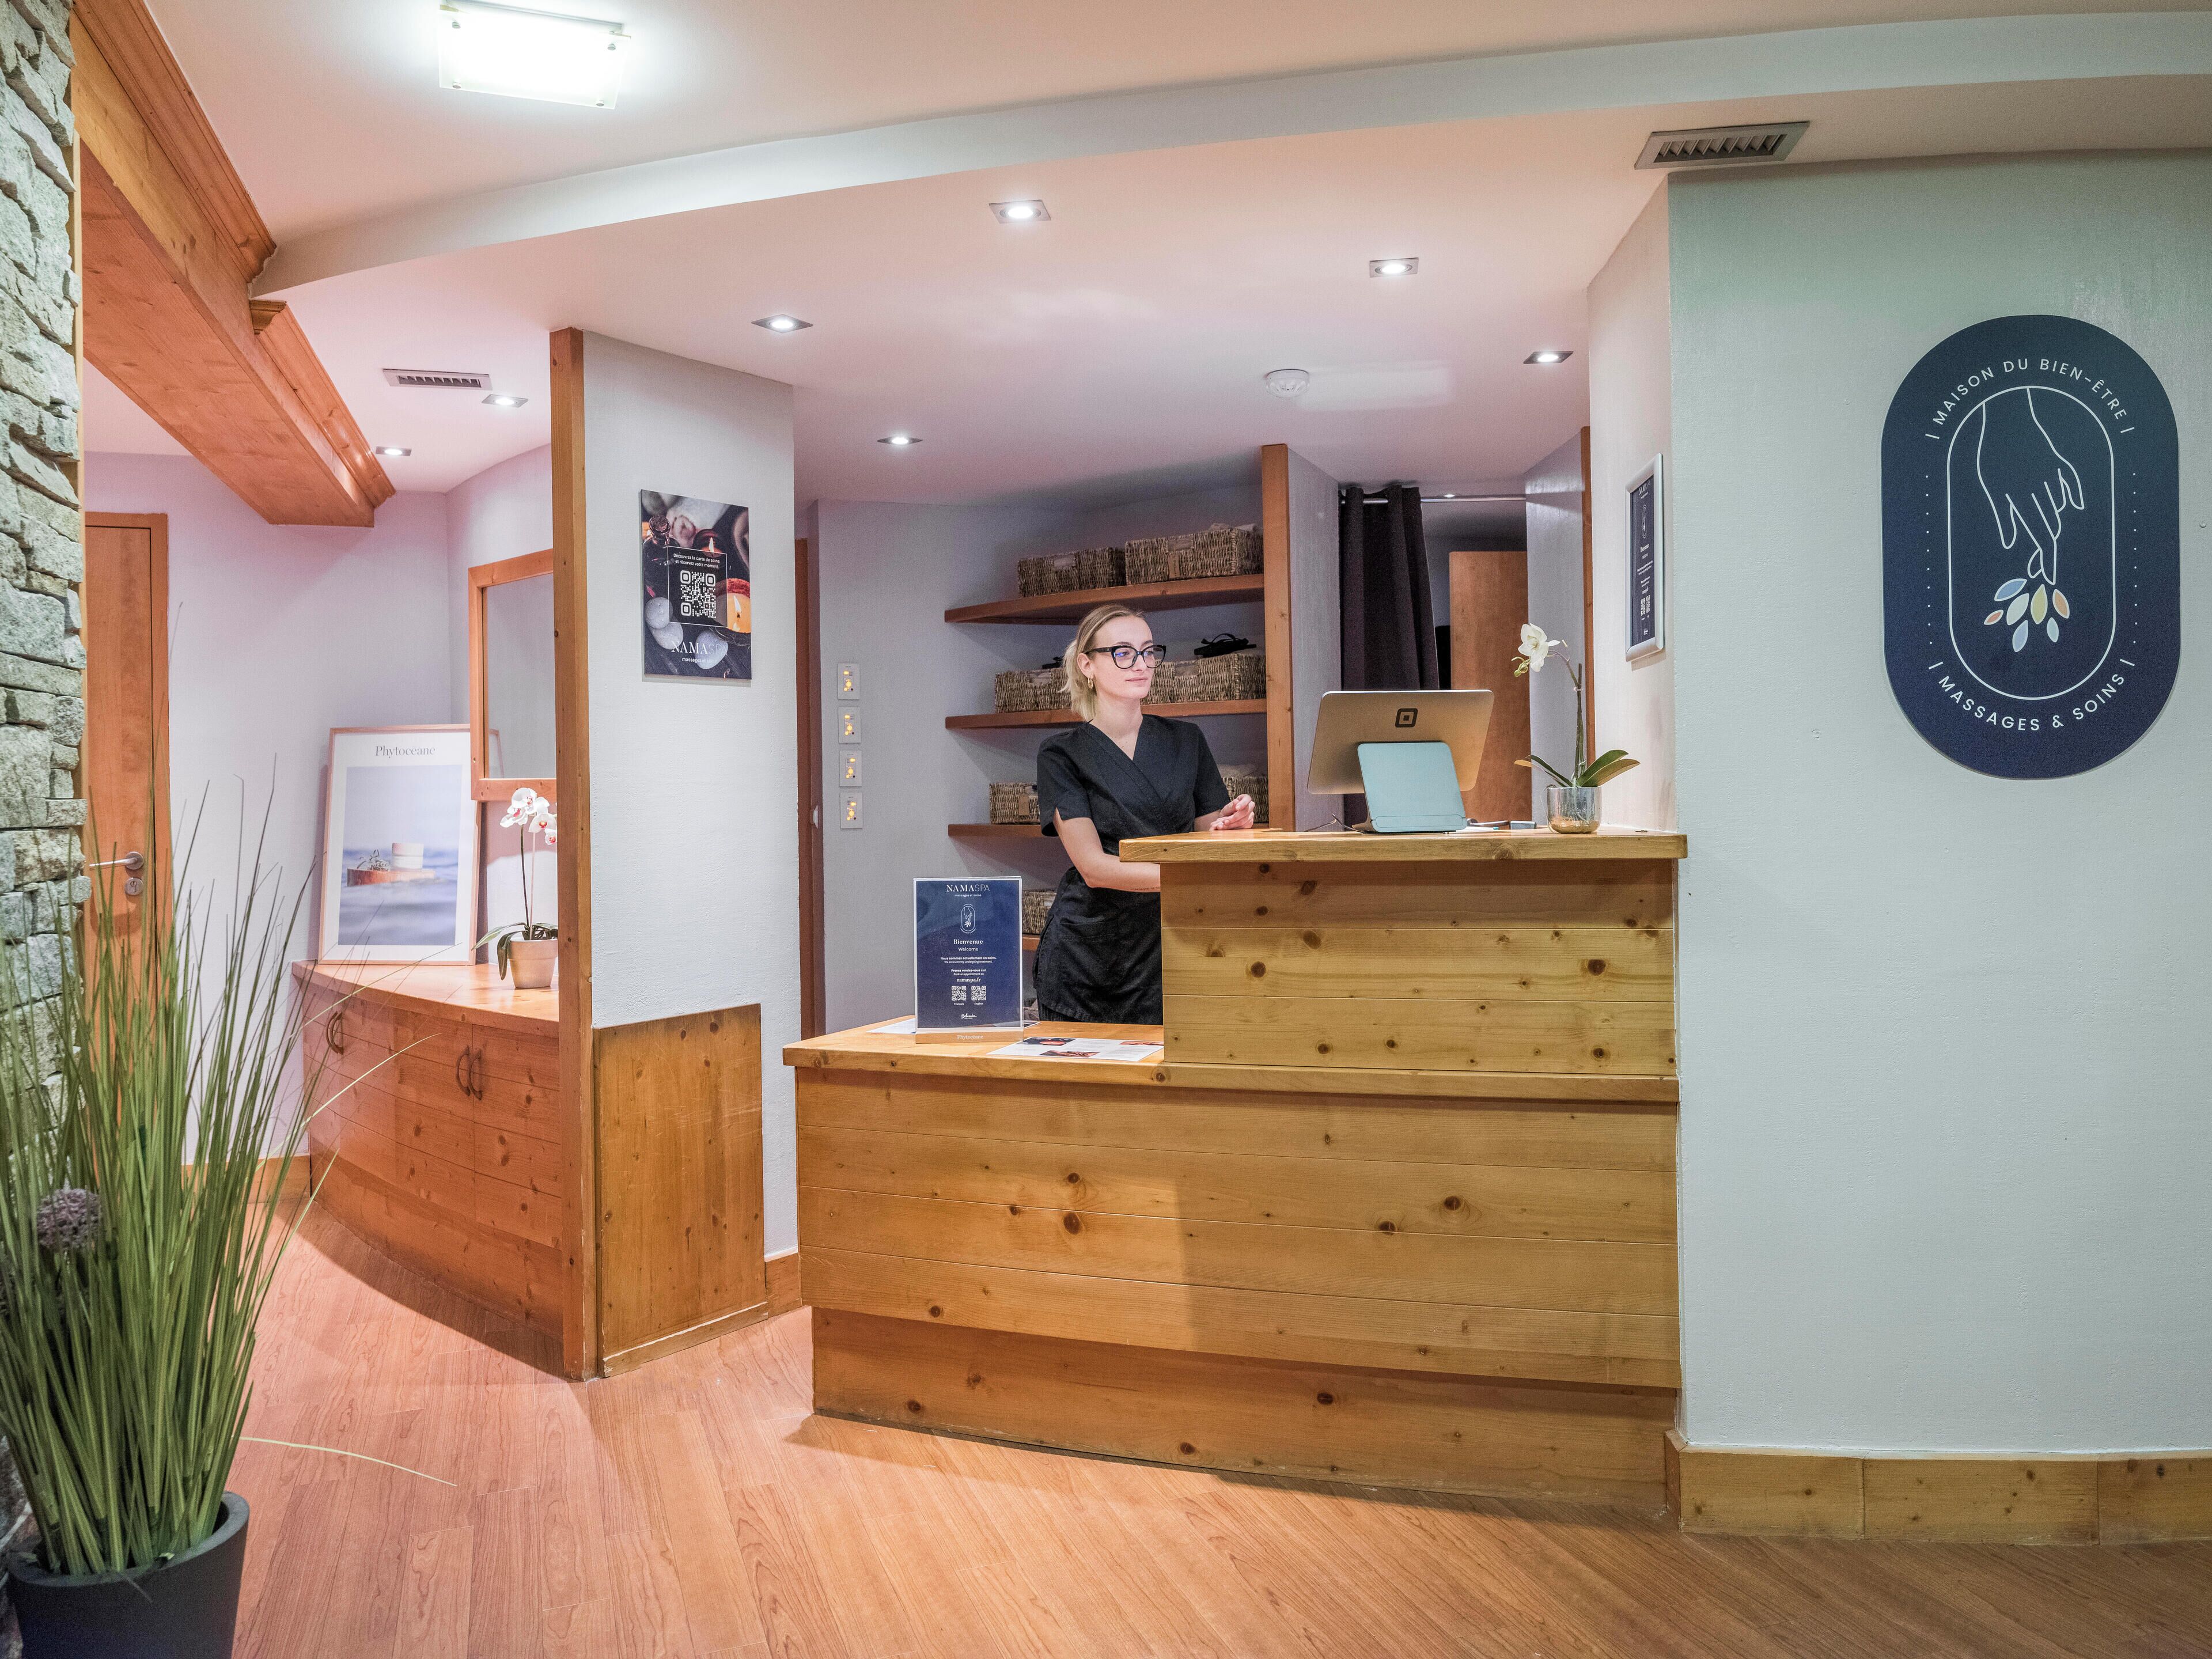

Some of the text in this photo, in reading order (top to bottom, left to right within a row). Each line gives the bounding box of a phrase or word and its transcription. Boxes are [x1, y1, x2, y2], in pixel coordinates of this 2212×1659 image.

[1933, 358, 2127, 425] MAISON DU BIEN-ÊTRE
[671, 640, 728, 656] NAMASPA
[1938, 673, 2124, 731] MASSAGES & SOINS
[946, 884, 990, 892] NAMASPA
